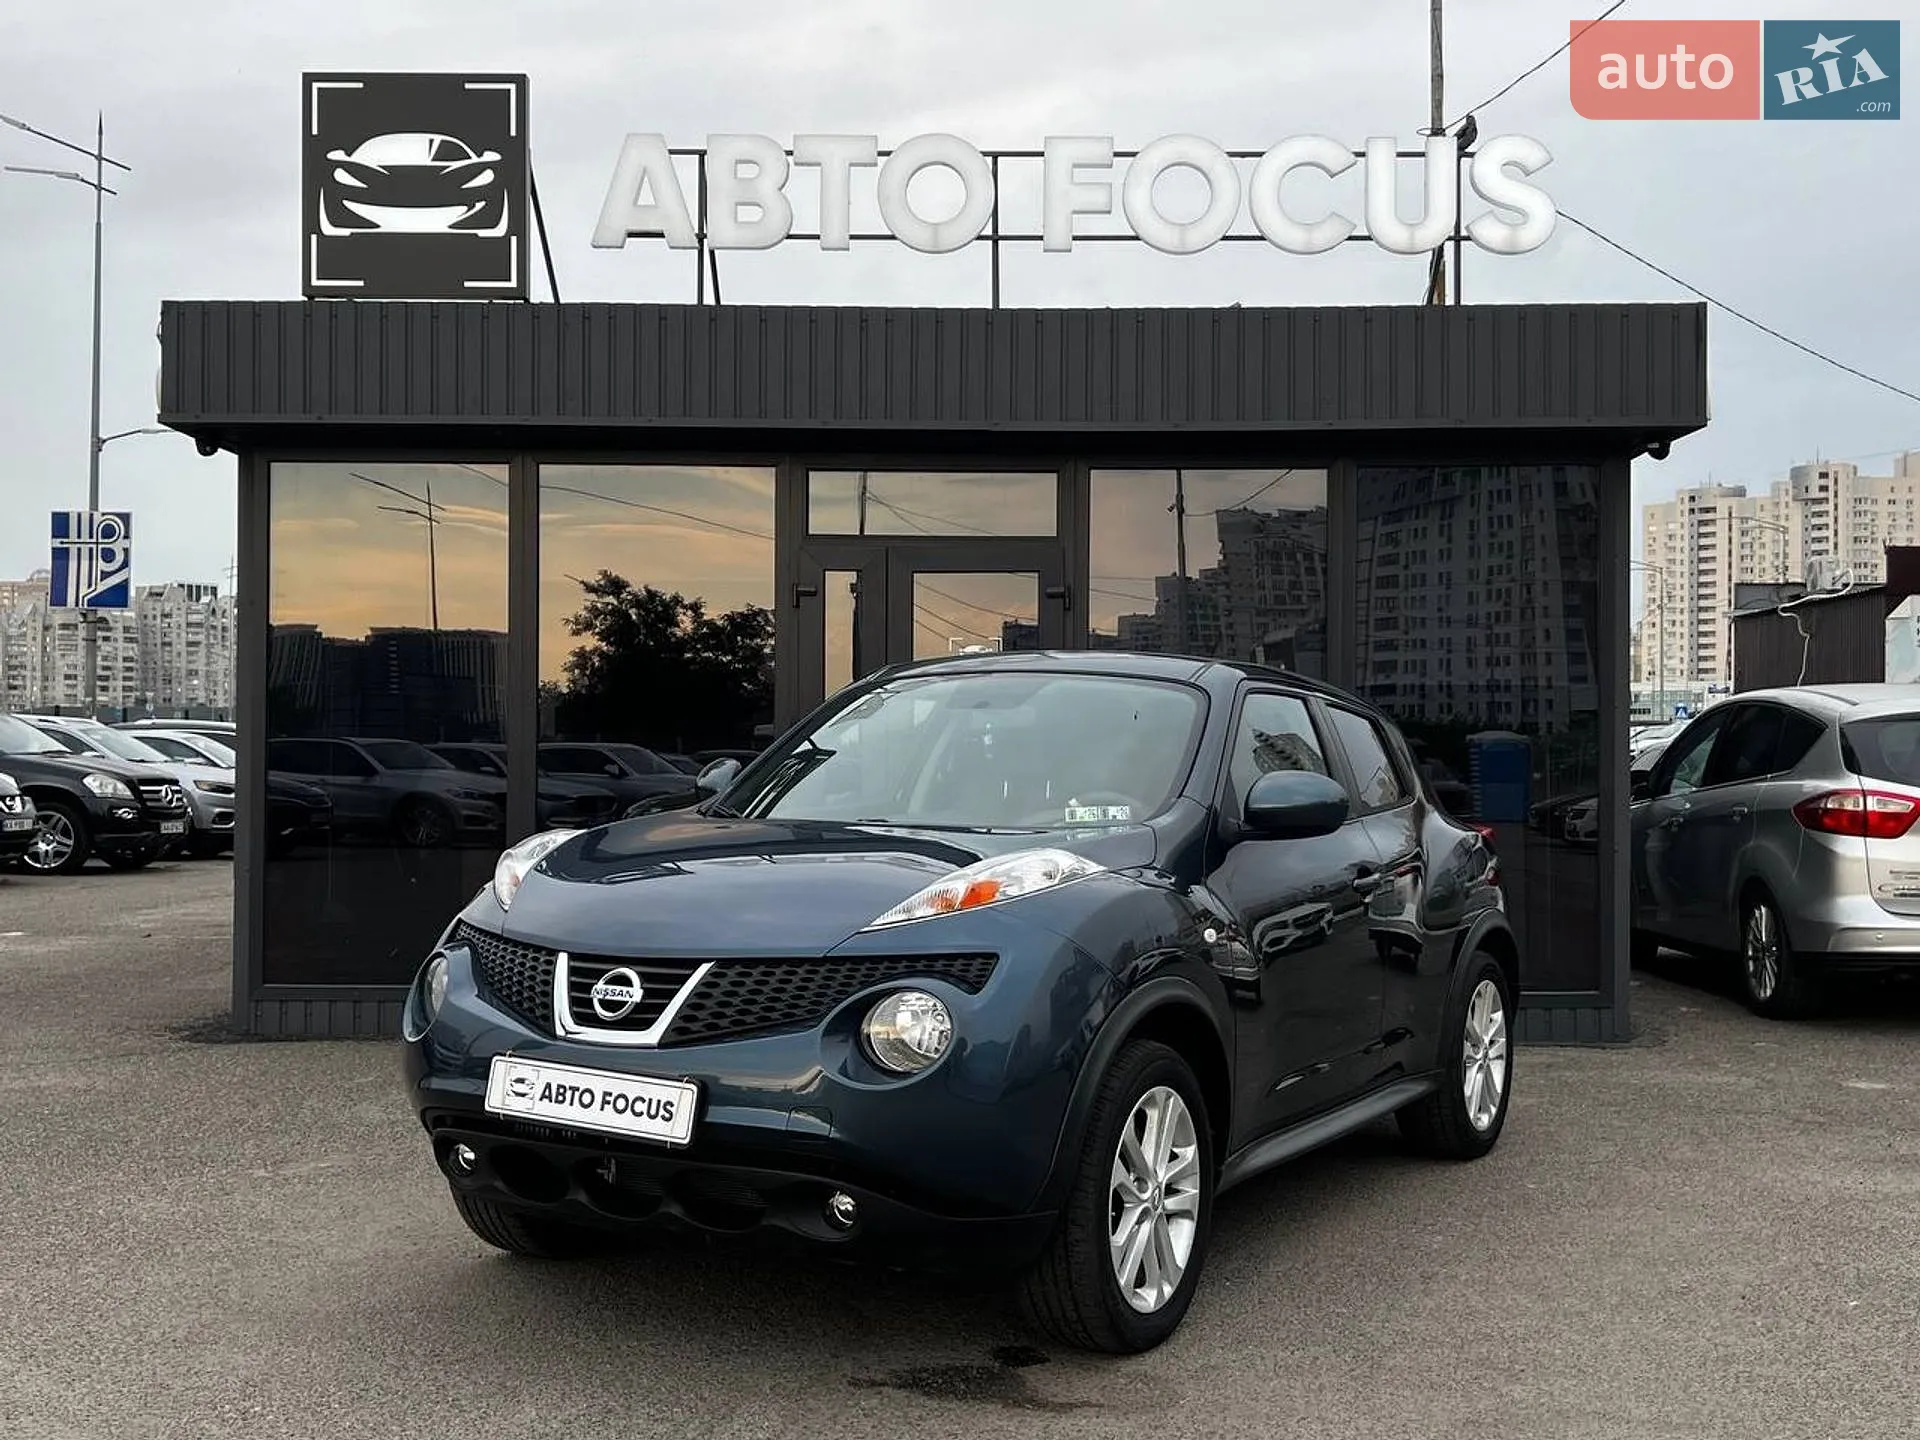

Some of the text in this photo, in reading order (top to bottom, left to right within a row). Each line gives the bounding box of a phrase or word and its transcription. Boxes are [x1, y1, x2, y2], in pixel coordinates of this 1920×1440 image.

[590, 133, 1557, 255] АВТО FOCUS
[592, 986, 634, 999] NISSAN
[539, 1082, 675, 1122] АВТО FOCUS
